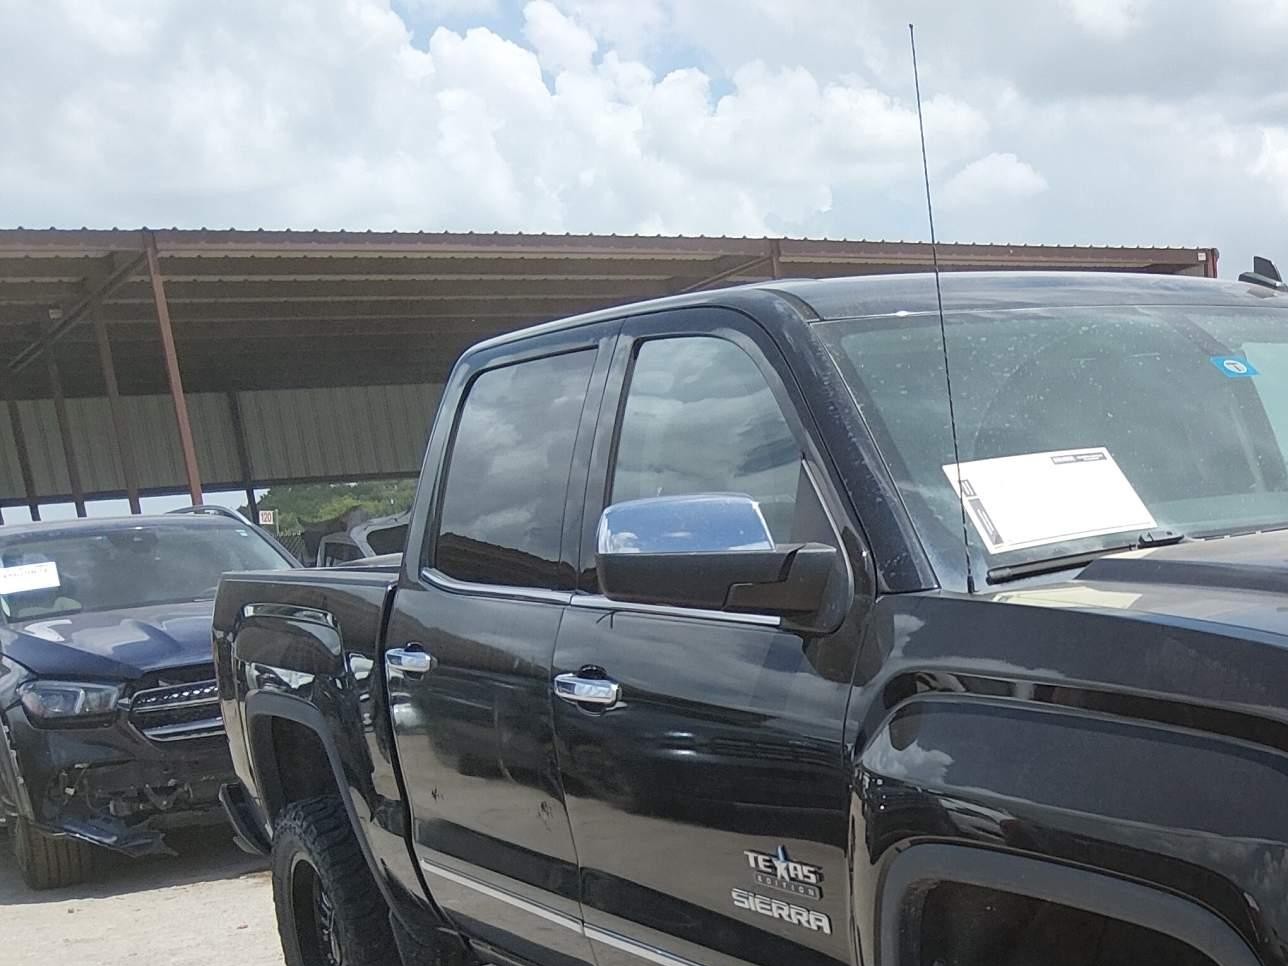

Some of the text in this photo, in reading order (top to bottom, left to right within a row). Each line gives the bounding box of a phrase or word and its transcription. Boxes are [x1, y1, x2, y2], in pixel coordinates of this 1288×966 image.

[261, 511, 272, 522] 120
[743, 845, 819, 884] TEXAS
[757, 874, 816, 897] EDITION
[731, 888, 832, 935] SIERRA
